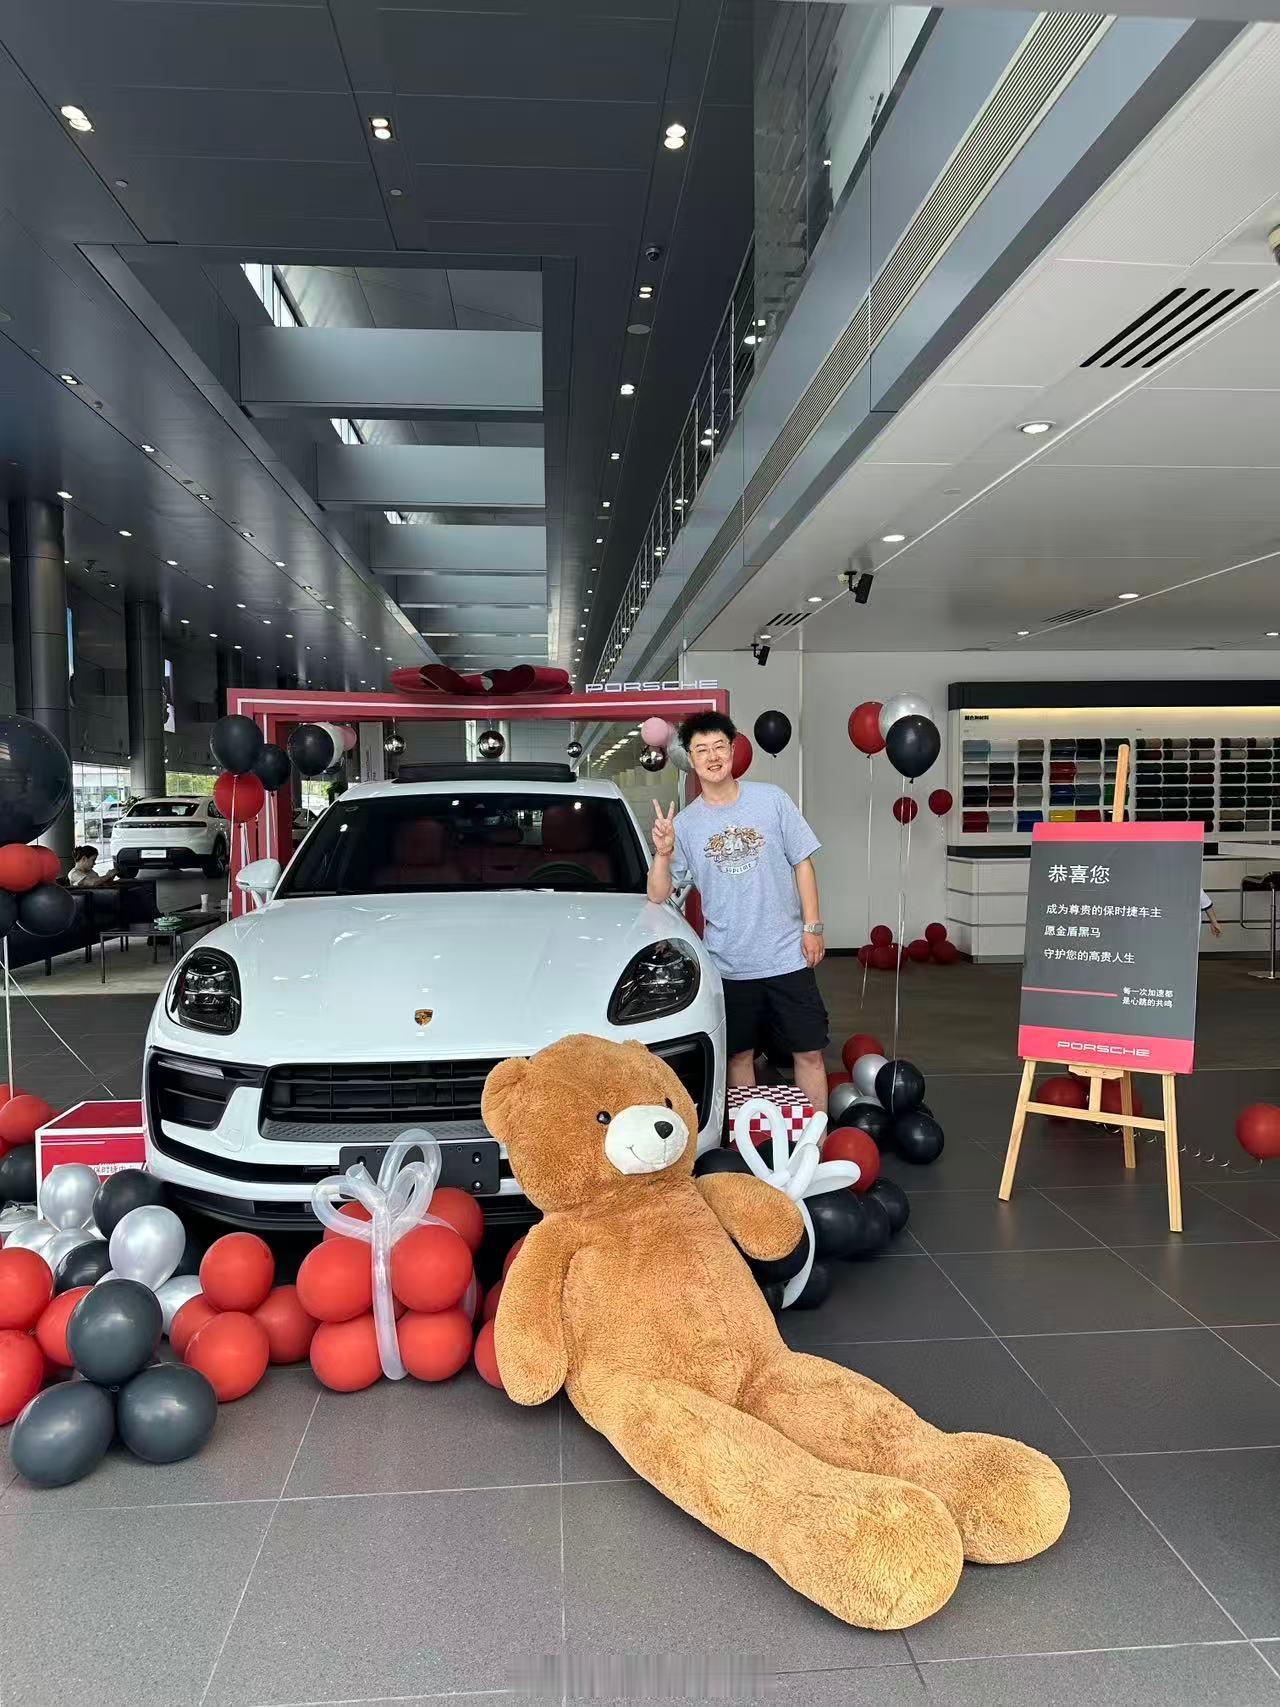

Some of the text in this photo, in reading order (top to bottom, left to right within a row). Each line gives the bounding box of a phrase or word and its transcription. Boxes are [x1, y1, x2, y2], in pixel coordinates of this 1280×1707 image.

[585, 680, 718, 693] PORSCHE
[1048, 864, 1110, 884] 恭喜您
[1046, 903, 1162, 918] 成为尊贵的保时捷车主
[1044, 925, 1101, 938] 愿金盾黑马
[1043, 948, 1135, 964] 守护您的高贵人生
[1123, 986, 1174, 998] 每一次加速都
[1122, 996, 1173, 1008] 是心跳的共鸣
[1057, 1041, 1150, 1057] PORSCHE
